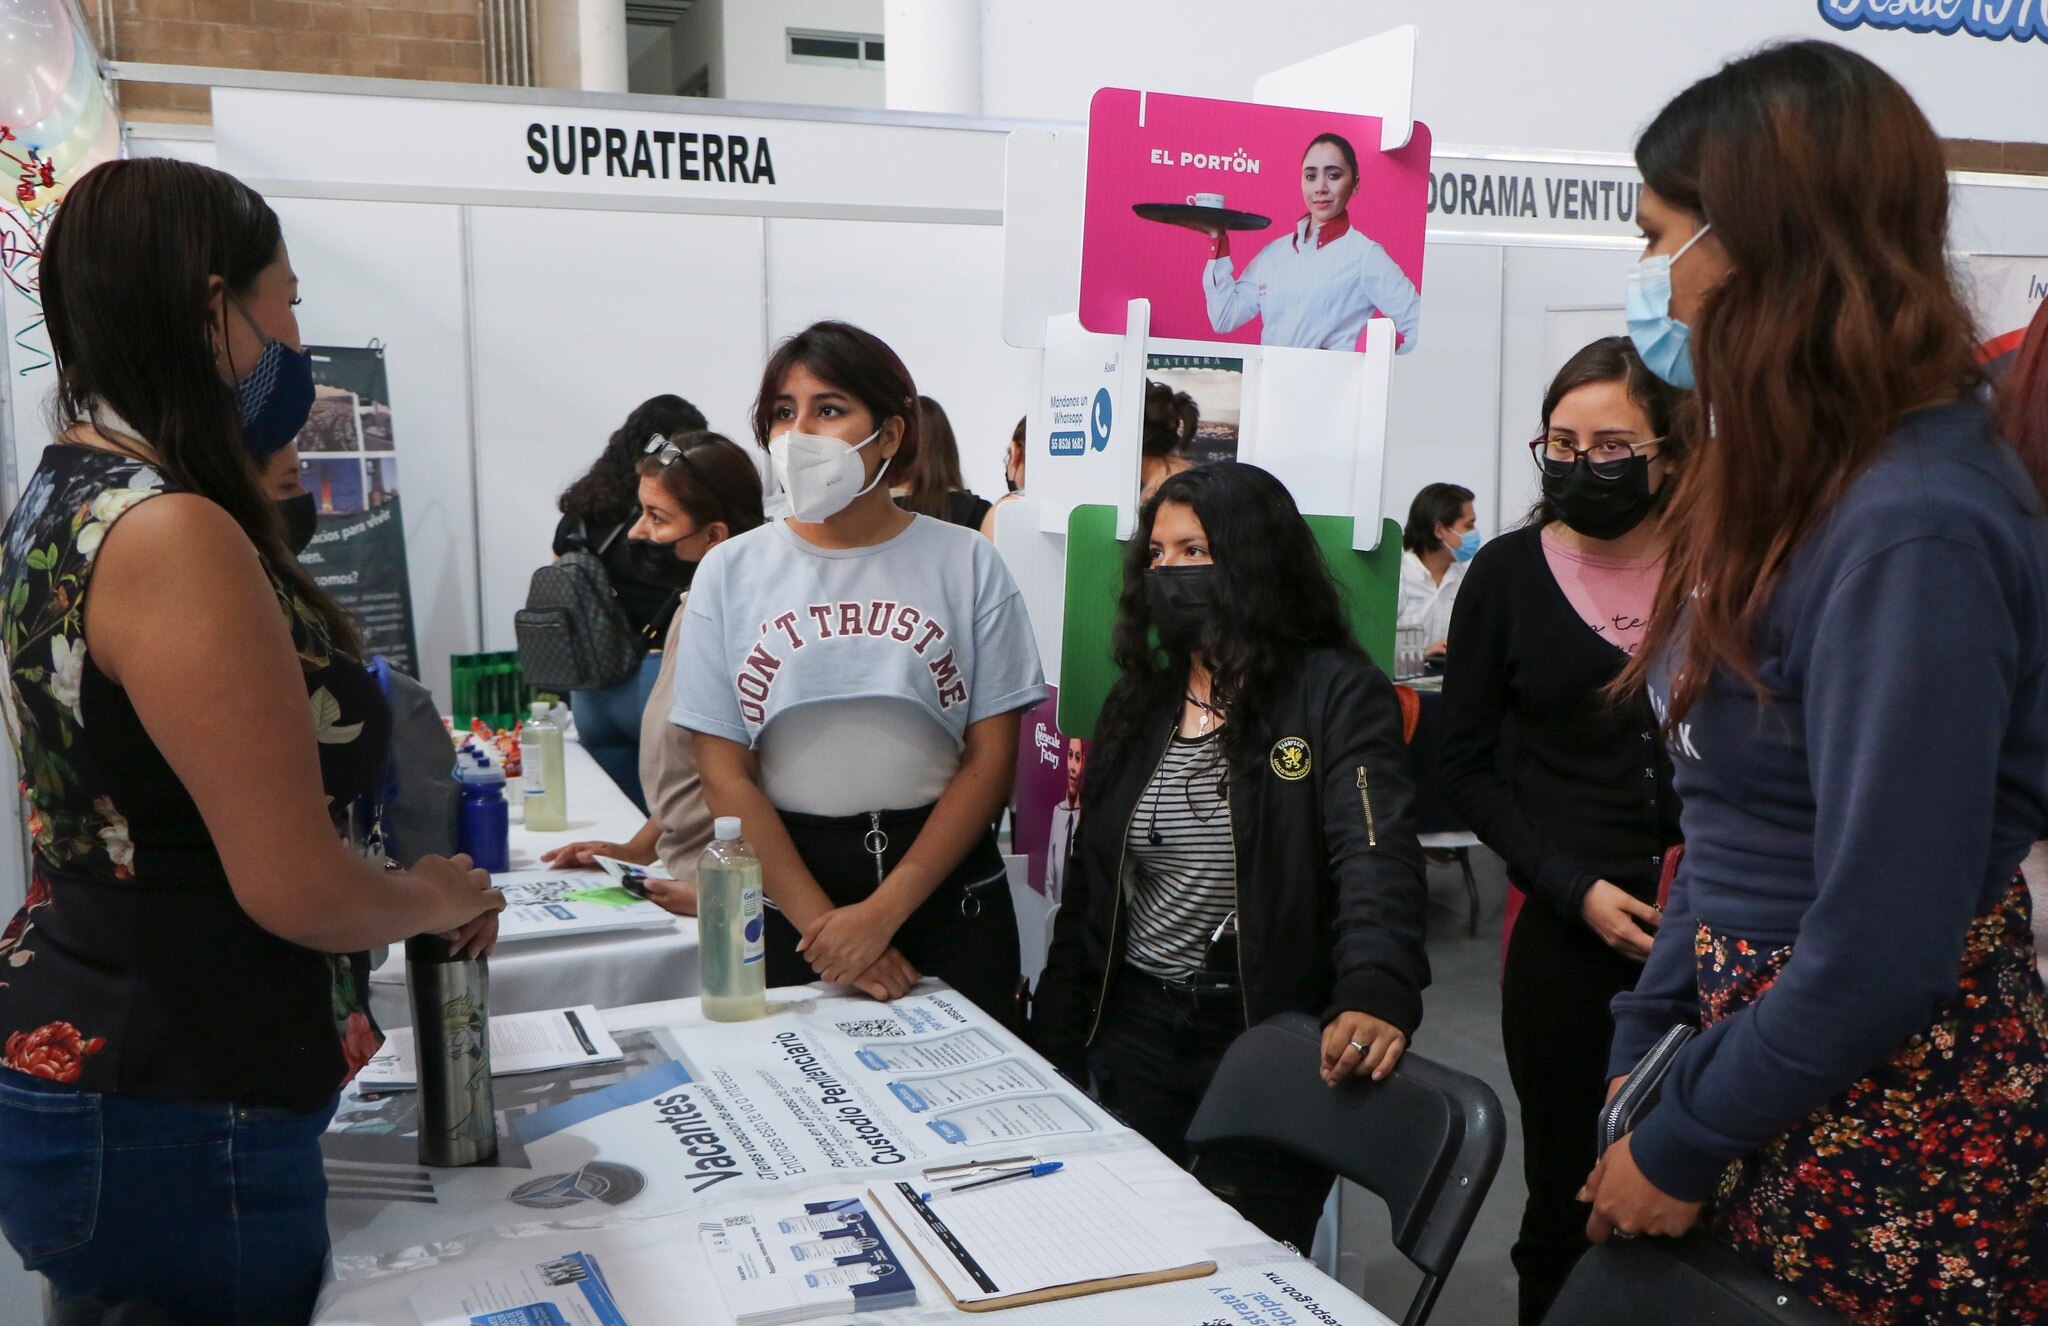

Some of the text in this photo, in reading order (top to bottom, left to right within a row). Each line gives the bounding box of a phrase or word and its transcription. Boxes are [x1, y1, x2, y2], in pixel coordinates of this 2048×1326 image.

[527, 123, 775, 184] SUPRATERRA
[1151, 148, 1260, 174] EL PORTÓN
[1545, 178, 1644, 222] VENTU
[1050, 395, 1088, 408] Mándanos un
[1054, 411, 1083, 426] Whatsapp
[1051, 437, 1084, 450] 55 8526 1682
[808, 600, 948, 656] TRUST
[927, 646, 969, 712] ME
[772, 1032, 853, 1104] Penitenciario
[717, 1113, 734, 1121] de
[740, 1104, 755, 1114] va
[747, 1114, 763, 1123] te
[783, 1099, 814, 1123] proceso
[799, 1096, 827, 1119] puesto
[726, 1122, 757, 1152] vocación
[754, 1122, 775, 1137] esto
[823, 1123, 853, 1149] ingresar
[836, 1107, 906, 1164] Custodio
[653, 1093, 744, 1194] Vacantes
[767, 1138, 806, 1175] Entonces
[816, 1138, 846, 1167] Participa
[749, 1154, 779, 1180] ¿Tienes
[846, 1151, 870, 1167] para
